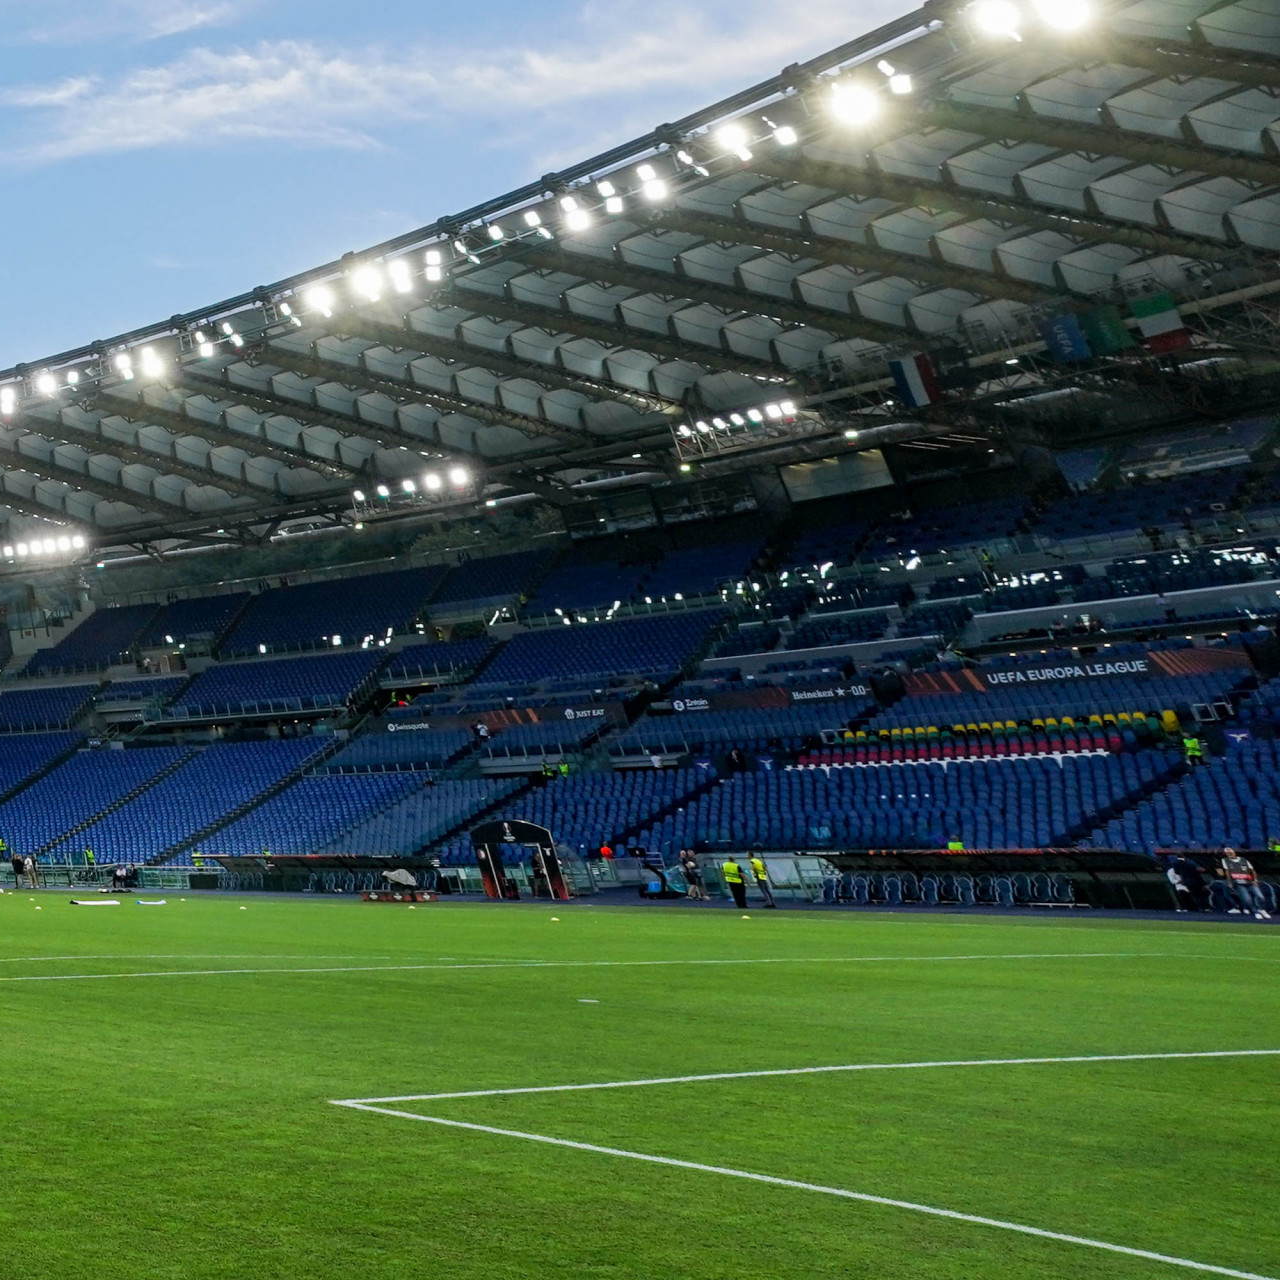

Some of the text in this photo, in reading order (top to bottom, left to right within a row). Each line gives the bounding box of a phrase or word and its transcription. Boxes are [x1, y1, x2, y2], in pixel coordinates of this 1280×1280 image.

[987, 660, 1148, 684] UEFA EUROPA LEAGUE
[791, 689, 834, 700] Heineken
[575, 708, 605, 718] JUST EAT
